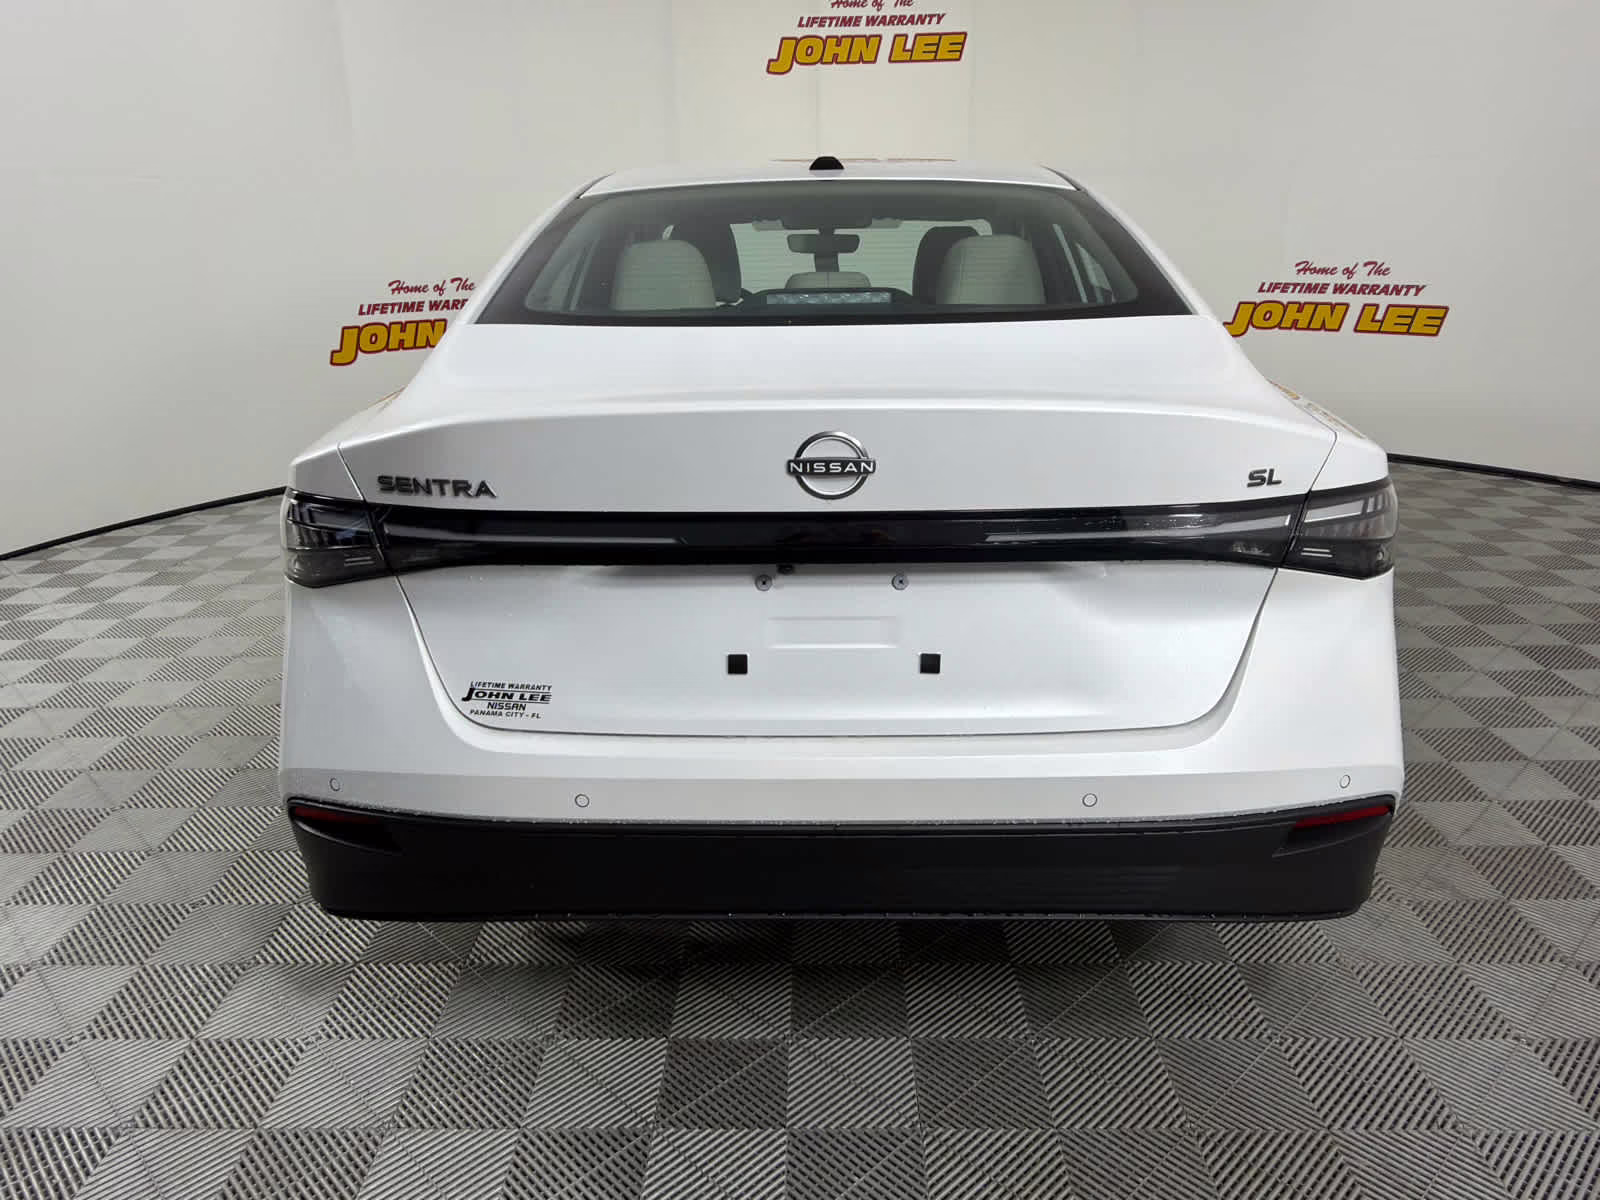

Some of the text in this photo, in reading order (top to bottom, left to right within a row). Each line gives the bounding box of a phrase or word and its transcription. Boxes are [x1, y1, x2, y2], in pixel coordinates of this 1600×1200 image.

[797, 13, 946, 28] LIFETIME WARRANTY
[766, 31, 968, 75] JOHN LEE
[1295, 260, 1391, 279] Home of The
[388, 277, 475, 296] Home of The
[1258, 282, 1426, 297] LIFETIME WARRANTY
[358, 300, 425, 316] LIFETIME
[1223, 300, 1449, 337] JOHN LEE
[330, 319, 447, 366] JOHN
[789, 462, 874, 473] NISSAN
[1247, 468, 1282, 488] SL
[377, 475, 497, 498] SENTRA
[470, 681, 552, 691] LIFETIME WARRANTY
[461, 687, 552, 702] JOHN LEE
[470, 709, 503, 717] PANAMA
[487, 702, 526, 711] NISSAN
